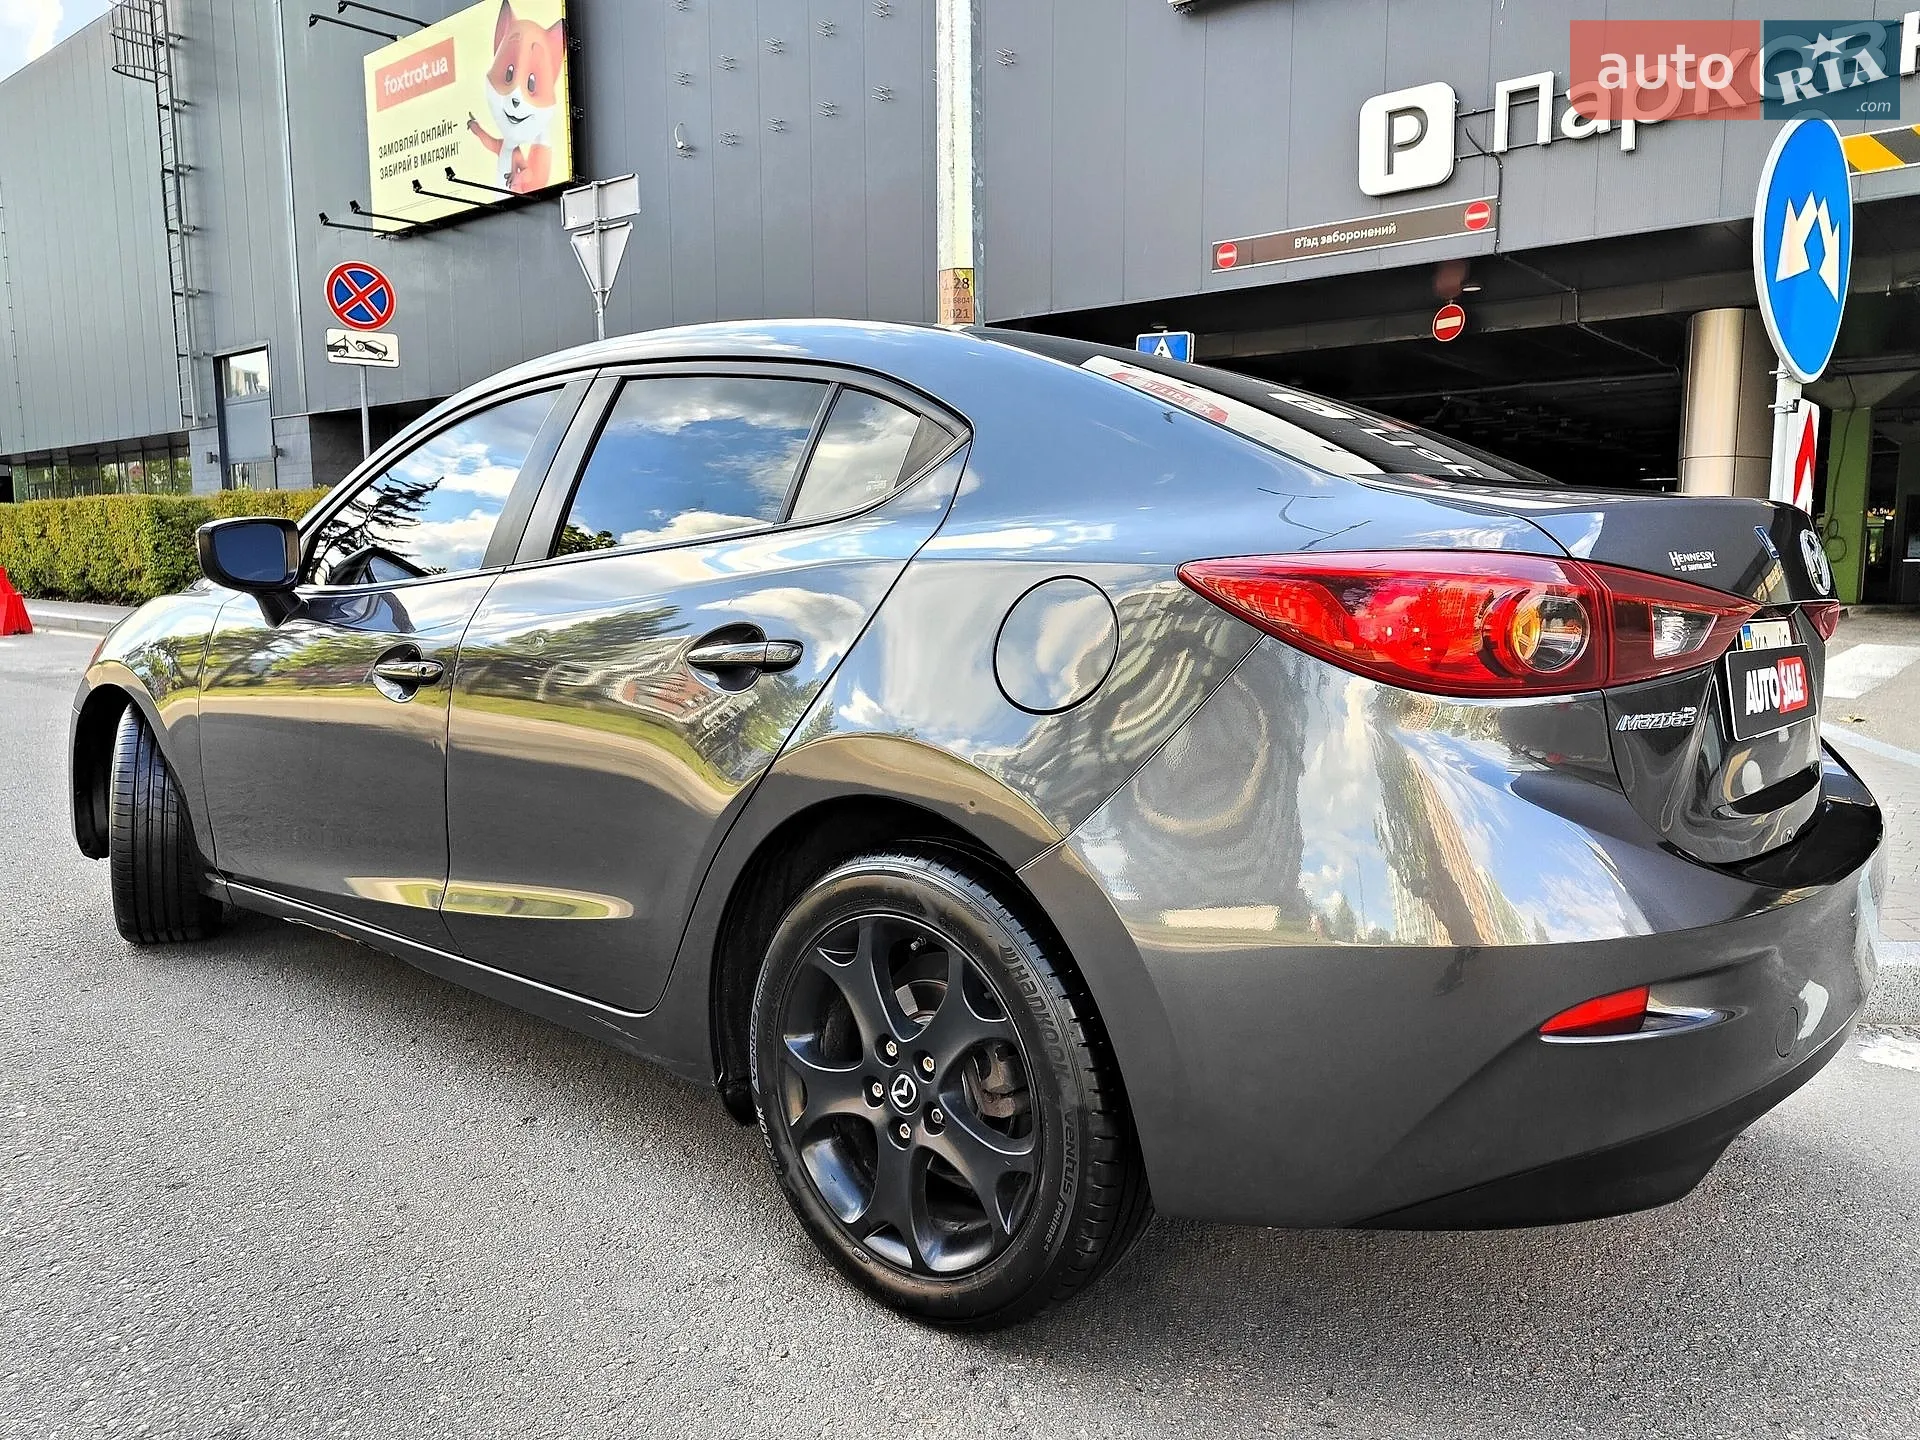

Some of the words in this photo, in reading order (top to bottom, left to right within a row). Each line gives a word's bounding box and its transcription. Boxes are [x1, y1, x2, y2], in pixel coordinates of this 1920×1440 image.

[383, 55, 449, 97] foxtrot.ua
[378, 129, 420, 159] ЗАМОВЛЯЙ
[379, 154, 413, 180] ЗАБИРАЙ
[413, 155, 419, 169] В
[1320, 222, 1397, 245] заборонений
